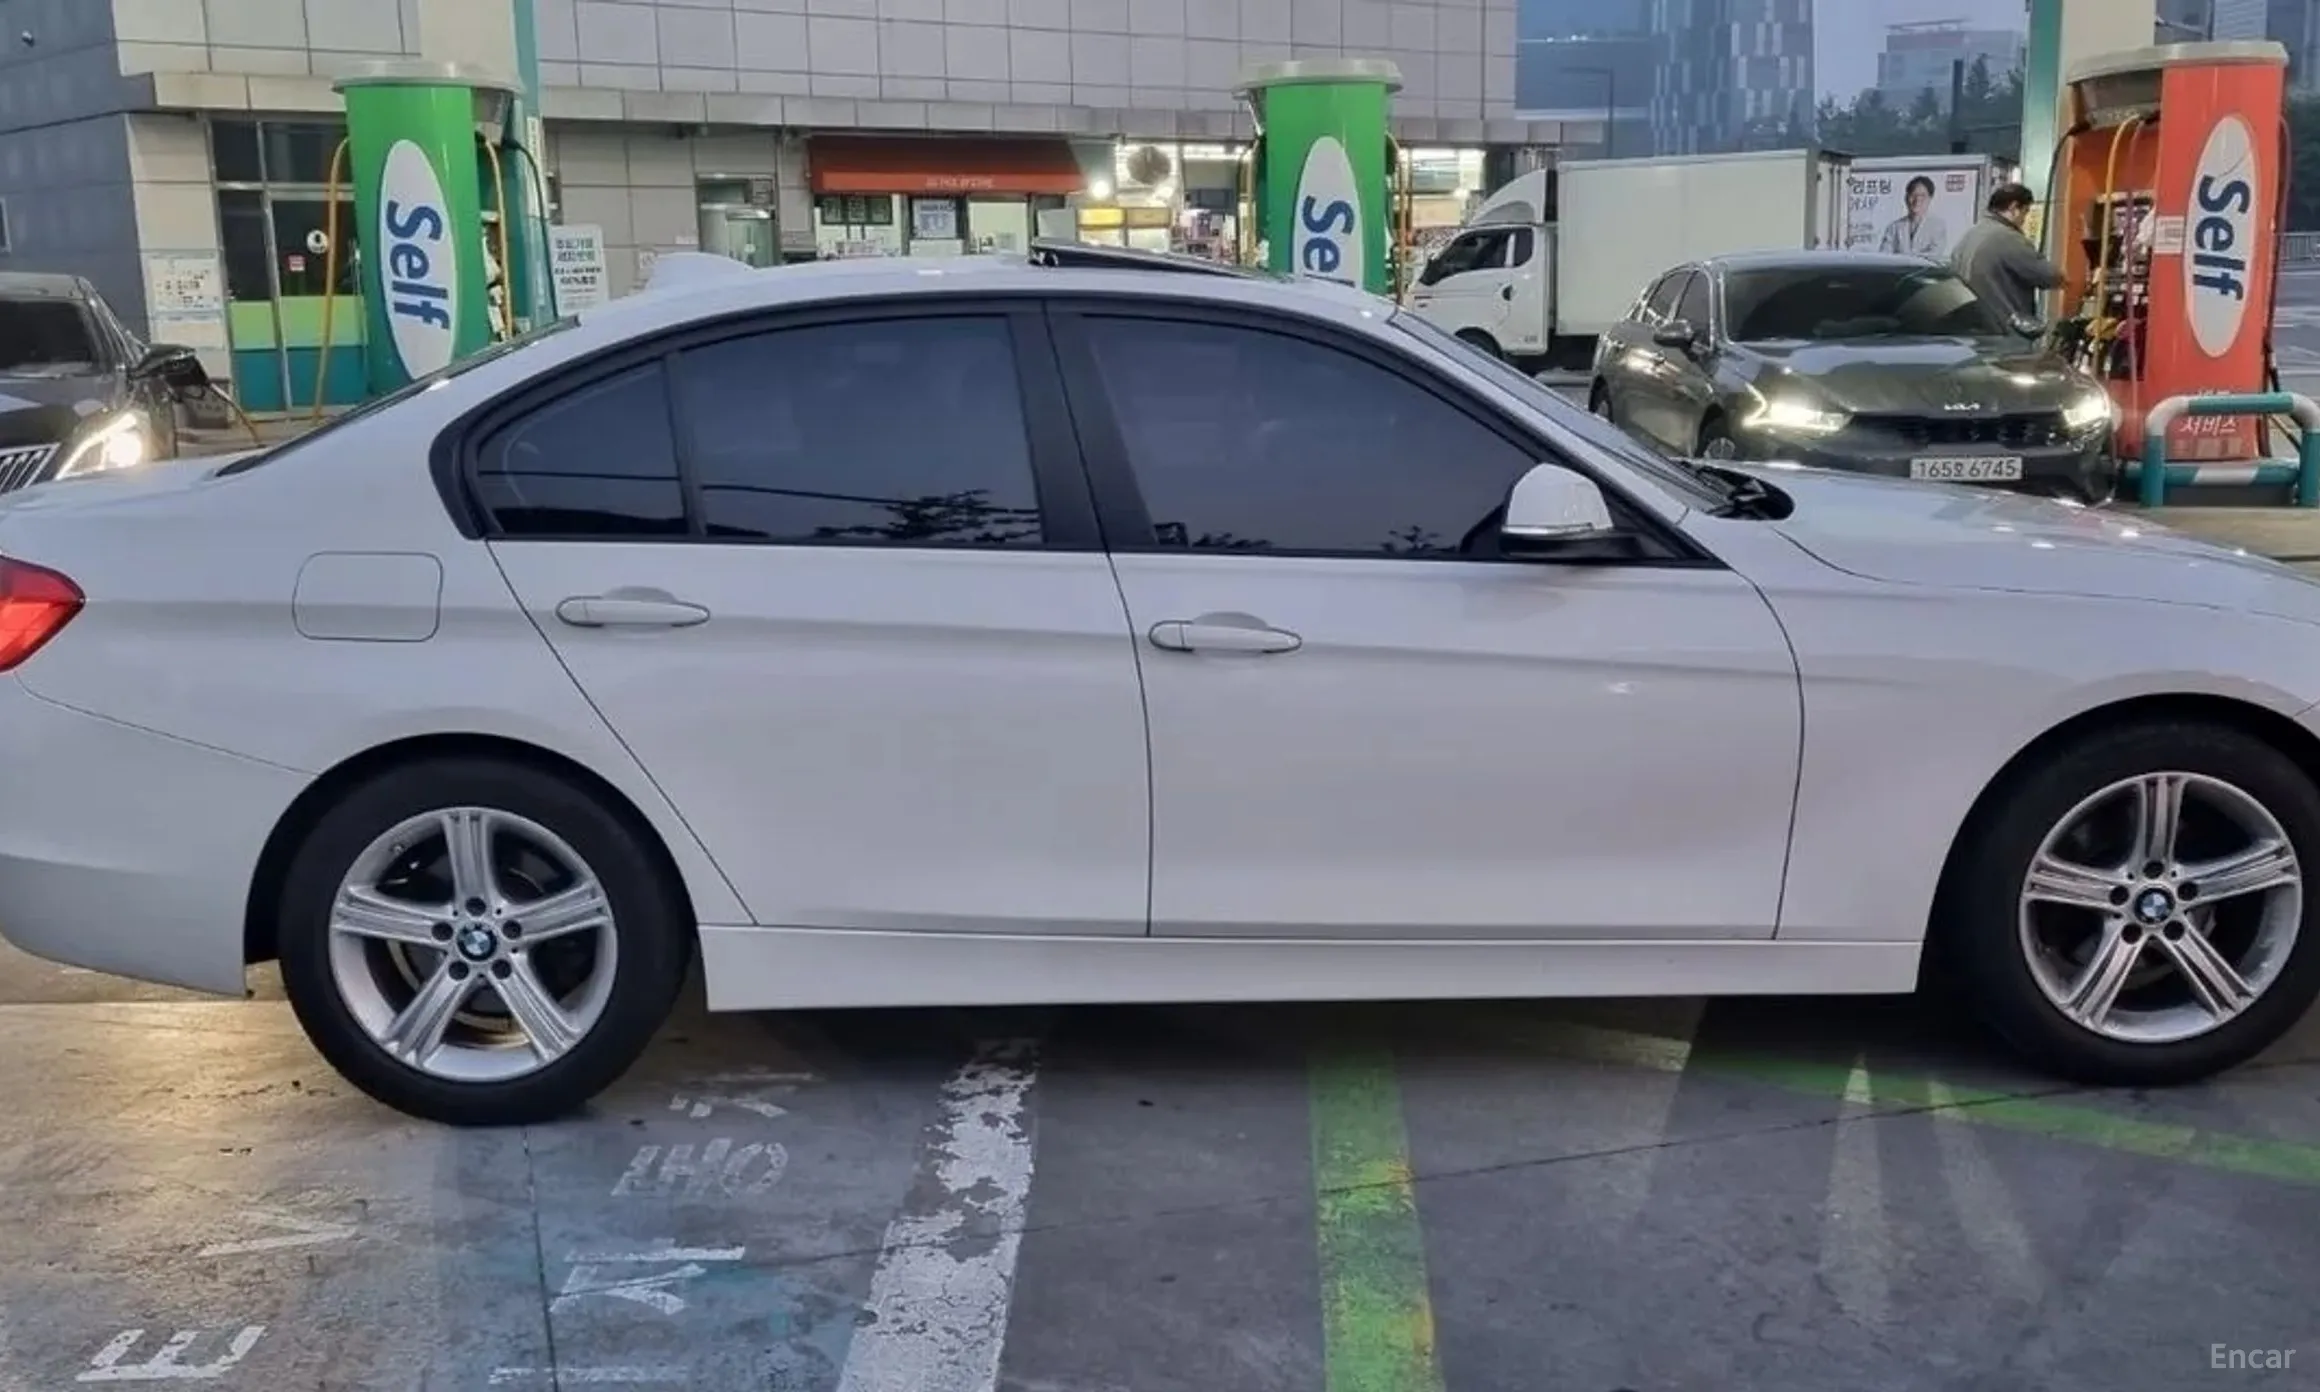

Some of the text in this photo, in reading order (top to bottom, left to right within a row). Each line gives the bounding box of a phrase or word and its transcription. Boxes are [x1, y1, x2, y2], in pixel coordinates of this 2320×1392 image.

[386, 200, 451, 331] Self
[2192, 174, 2251, 301] Self
[2180, 413, 2237, 437] 서비스
[1968, 459, 2017, 478] 6745
